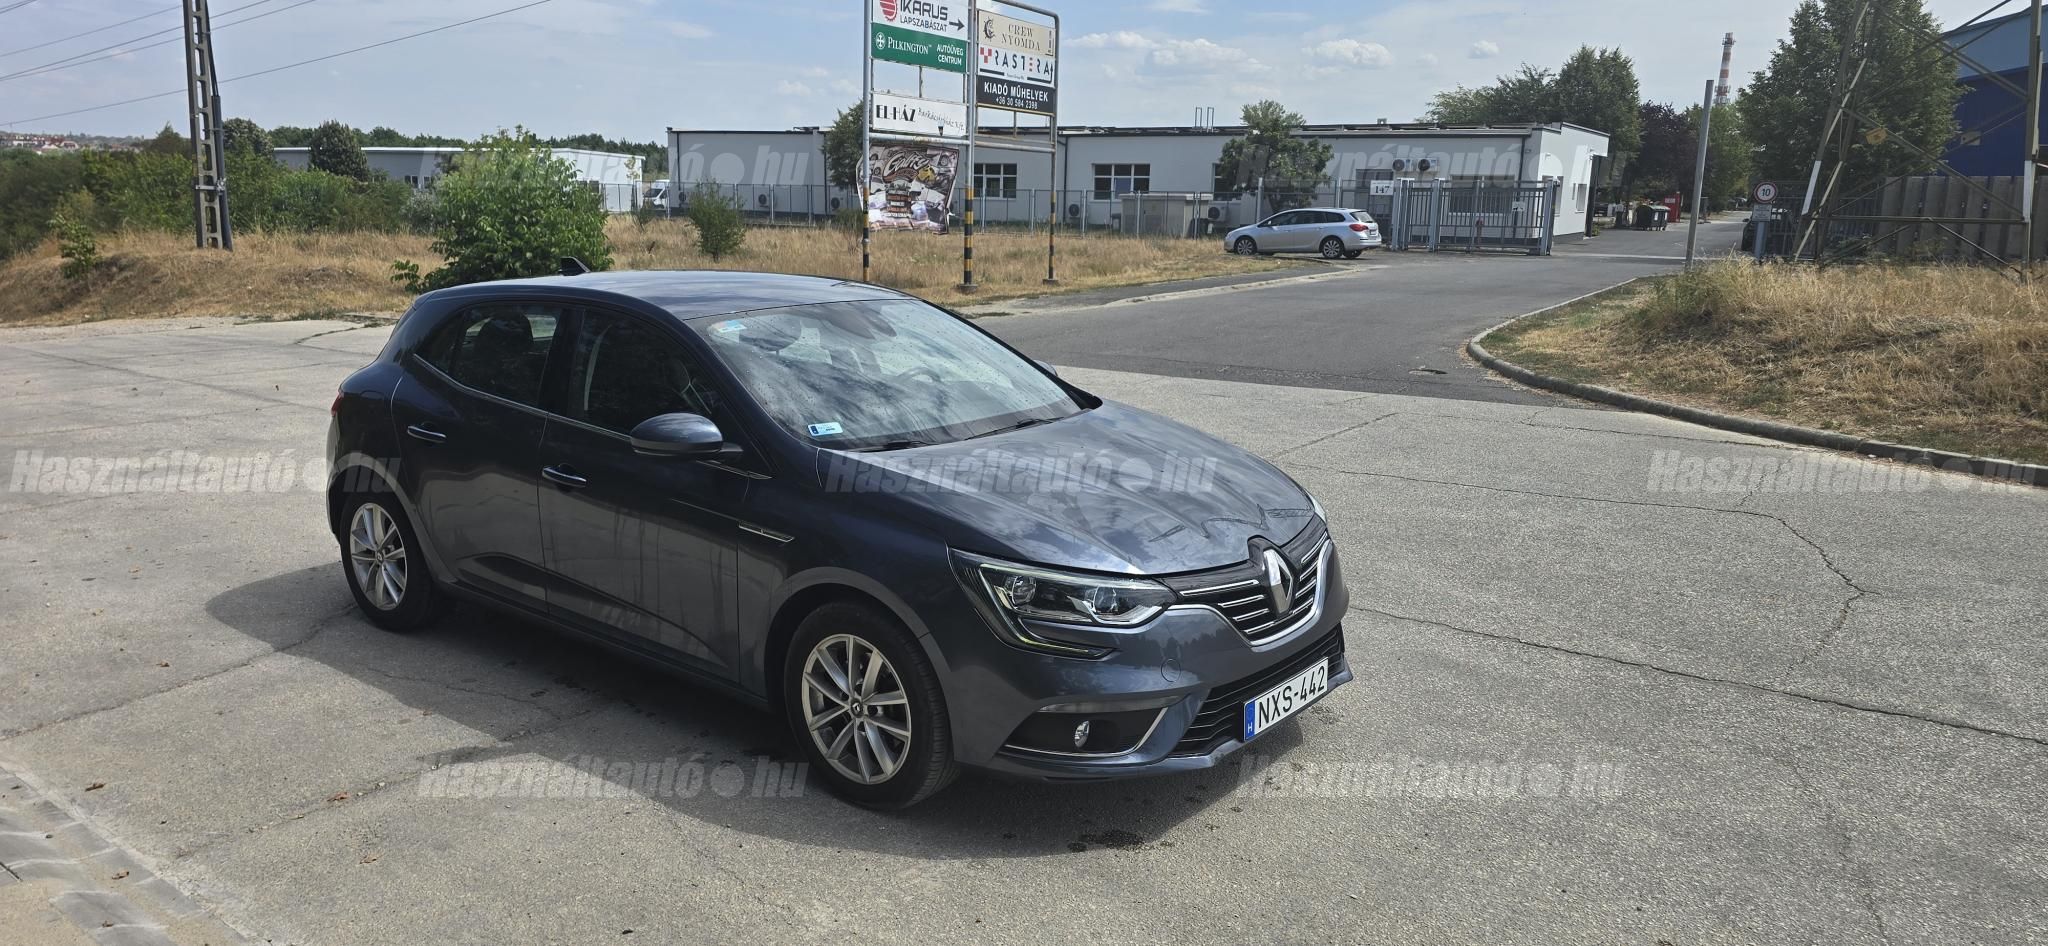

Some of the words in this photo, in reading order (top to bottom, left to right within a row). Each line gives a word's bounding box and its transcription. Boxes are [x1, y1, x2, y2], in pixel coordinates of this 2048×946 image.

[900, 0, 948, 21] IKARUS
[900, 16, 947, 32] LAPSZABÁSZAT
[1008, 24, 1033, 37] CREW
[1001, 33, 1041, 52] NYOMDA
[937, 54, 962, 66] CENTRUM
[984, 81, 1009, 96] KIADÓ
[1010, 85, 1049, 102] MŰHELYEK
[1007, 97, 1014, 106] 30
[1375, 185, 1390, 194] 147
[1762, 188, 1771, 197] 10
[1258, 665, 1326, 729] NXS-442
